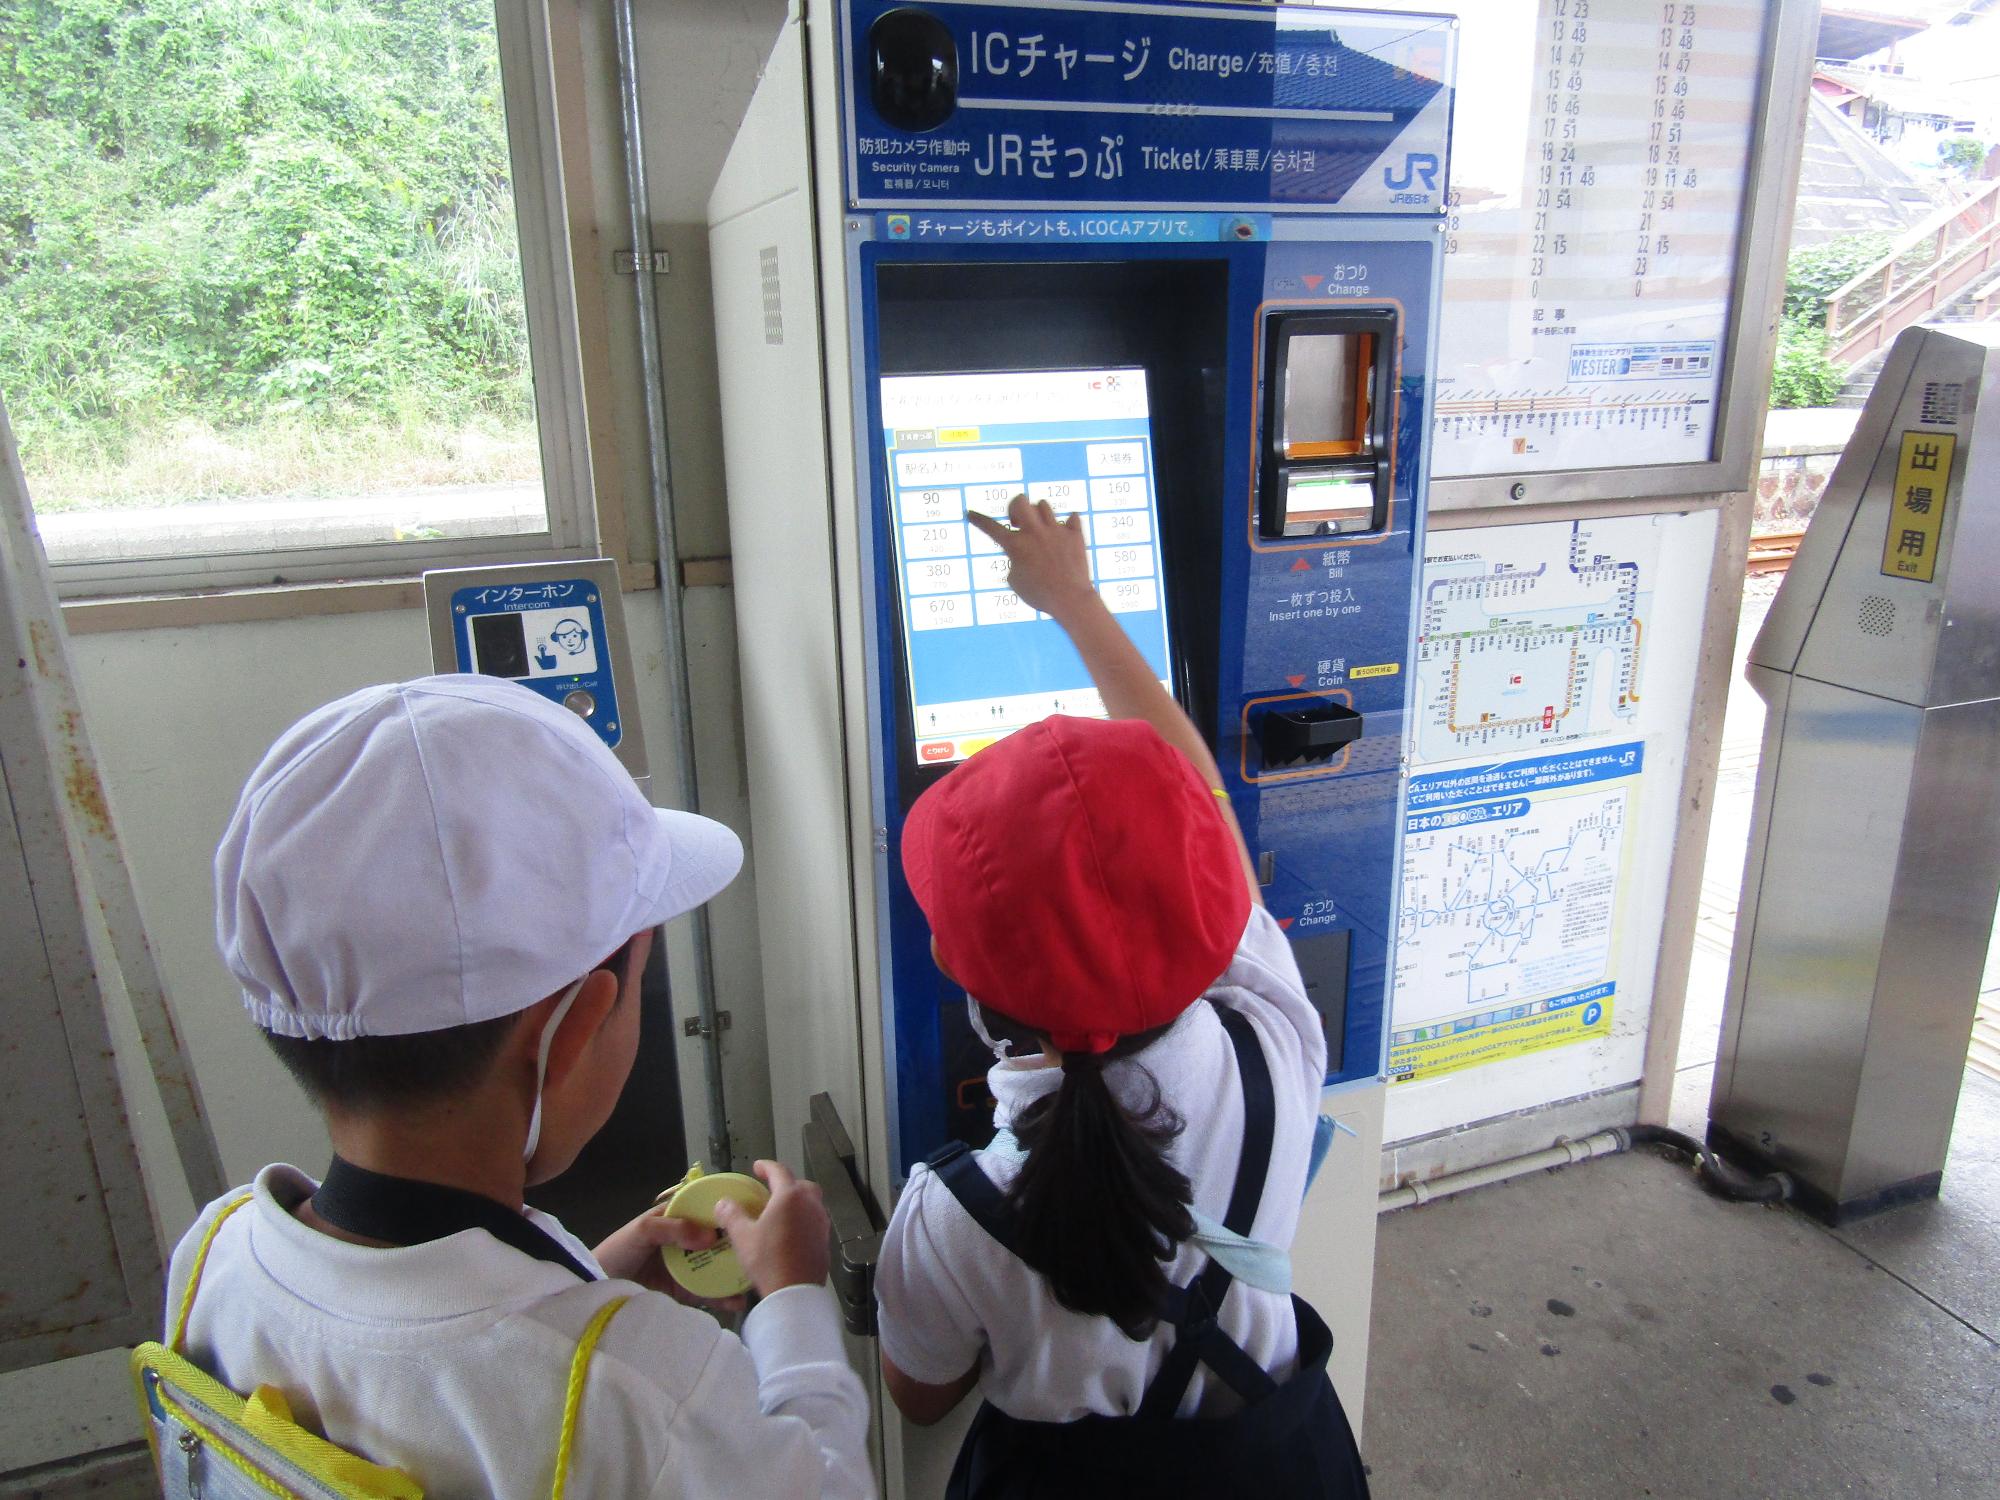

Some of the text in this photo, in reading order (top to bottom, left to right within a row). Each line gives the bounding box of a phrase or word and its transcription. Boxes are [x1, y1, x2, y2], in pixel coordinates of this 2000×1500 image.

[1574, 3, 1589, 18] 23
[1664, 4, 1695, 26] 12 23
[1553, 21, 1586, 43] 13 48
[1661, 28, 1693, 50] 13 48
[971, 30, 1151, 81] ICチャージ
[1551, 46, 1585, 68] 14 47
[1659, 51, 1690, 73] 14 47
[1549, 70, 1582, 91] 15 49
[1656, 76, 1688, 97] 15 49
[1546, 94, 1580, 115] 16 46
[1654, 99, 1685, 120] 16 46
[1544, 118, 1577, 139] 17 51
[1651, 122, 1682, 143] 17 51
[859, 138, 971, 157] 防犯カメラ作動中
[974, 133, 1124, 180] JRきっぷ
[1542, 142, 1575, 163] 18 24
[1648, 144, 1680, 165] 18 24
[872, 161, 960, 175] Security Camera
[1383, 153, 1439, 191] JR
[1540, 166, 1595, 186] 19 11 48
[1646, 168, 1697, 188] 19 11 48
[1537, 188, 1571, 209] 20 54
[1642, 190, 1675, 210] 20 54
[917, 219, 1195, 238] チャージもポイントも、ICOCAアプリで。
[1535, 212, 1547, 231] 21
[1640, 212, 1652, 231] 21
[1533, 235, 1567, 255] 22 15
[1637, 235, 1670, 255] 22 15
[1333, 264, 1368, 281] おつり
[1531, 258, 1543, 276] 23
[1634, 257, 1647, 276] 23
[1327, 283, 1370, 297] Change
[1571, 358, 1616, 377] WESTER
[985, 488, 1008, 501] 100
[1048, 485, 1070, 497] 120
[1109, 481, 1131, 494] 160
[922, 492, 940, 505] 90
[1897, 442, 1939, 557] 出場用
[1111, 515, 1134, 528] 340
[922, 528, 948, 542] 210
[1114, 550, 1137, 562] 580
[1323, 550, 1351, 567] 紙幣
[926, 564, 951, 577] 380
[1328, 567, 1343, 579] Bill
[1898, 560, 1917, 573] Exit
[475, 584, 575, 604] インターホン
[993, 593, 1019, 607] 760
[1116, 584, 1140, 597] 990
[1277, 587, 1355, 607] 一枚ずつ投入
[504, 602, 551, 612] Intercom
[929, 599, 955, 613] 670
[1269, 605, 1361, 622] Insert one by one
[1317, 658, 1345, 674] 硬貨
[1318, 675, 1343, 687] Coin
[1619, 751, 1635, 764] JR
[1303, 899, 1334, 916] おつり
[1299, 913, 1337, 927] Change
